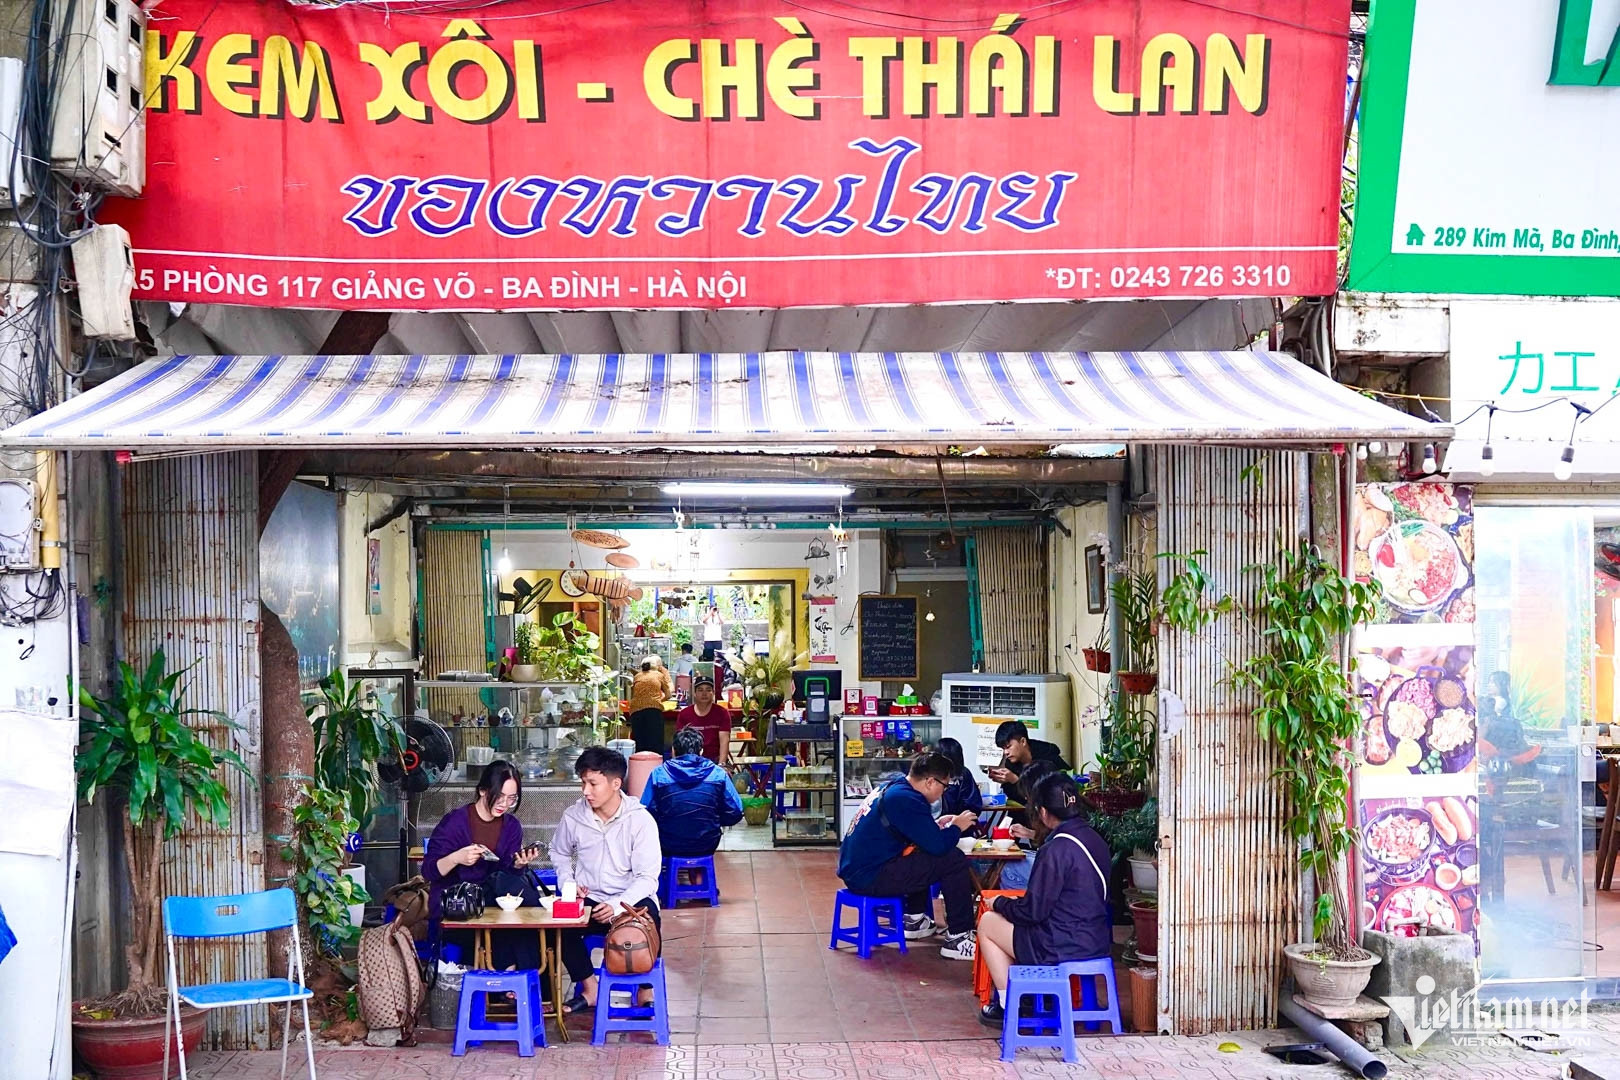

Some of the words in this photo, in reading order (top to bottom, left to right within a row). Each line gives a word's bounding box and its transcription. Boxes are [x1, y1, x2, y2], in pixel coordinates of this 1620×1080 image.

[145, 30, 340, 120] KEM
[359, 18, 541, 121] XÔI
[576, 82, 609, 101] -
[643, 17, 818, 119] CHÈ
[848, 13, 1057, 118] THÁI
[1092, 32, 1267, 114] LAN
[1433, 226, 1467, 247] 289
[1472, 227, 1506, 249] Kim
[1512, 226, 1545, 253] Mã,
[1551, 228, 1576, 249] Ba
[132, 268, 155, 291] 5
[163, 264, 268, 297] PHÒNG
[277, 276, 323, 298] 117
[331, 270, 426, 300] GIẢNG
[432, 272, 476, 299] VÕ
[502, 277, 544, 299] BA
[549, 272, 620, 299] ĐÌNH
[647, 271, 689, 299] HÀ
[696, 271, 747, 303] NỘI
[1110, 265, 1171, 288] 0243
[1179, 265, 1224, 288] 726
[1231, 265, 1291, 288] 3310
[1498, 340, 1620, 396] カエ
